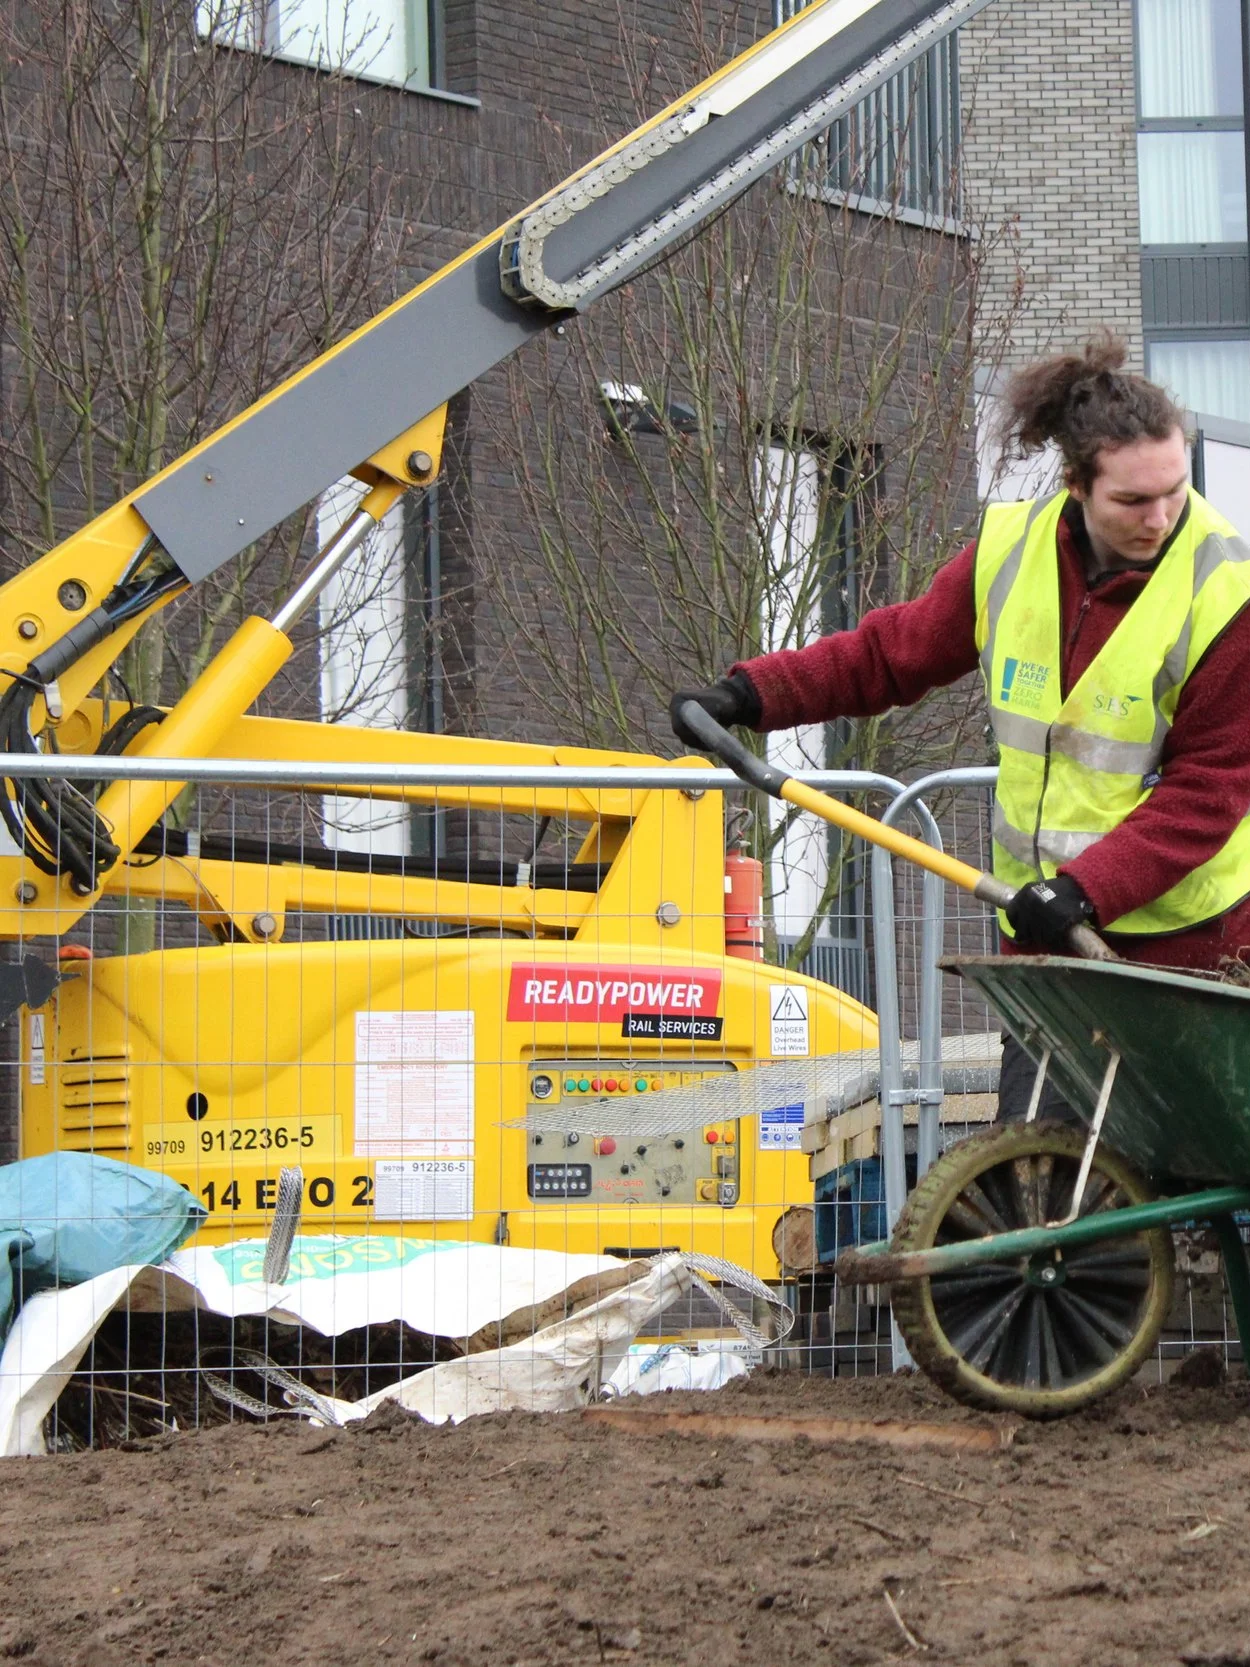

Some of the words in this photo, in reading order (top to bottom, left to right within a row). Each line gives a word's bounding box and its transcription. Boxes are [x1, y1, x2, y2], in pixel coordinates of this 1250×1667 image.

[1017, 669, 1047, 683] SAFER
[524, 979, 704, 1008] READYPOWER
[628, 1019, 655, 1033] RAIL
[658, 1020, 716, 1035] SERVICES
[774, 1026, 804, 1034] DANGER
[147, 1139, 186, 1156] 99709
[200, 1126, 315, 1152] 912236-5
[412, 1162, 466, 1173] 912236-5
